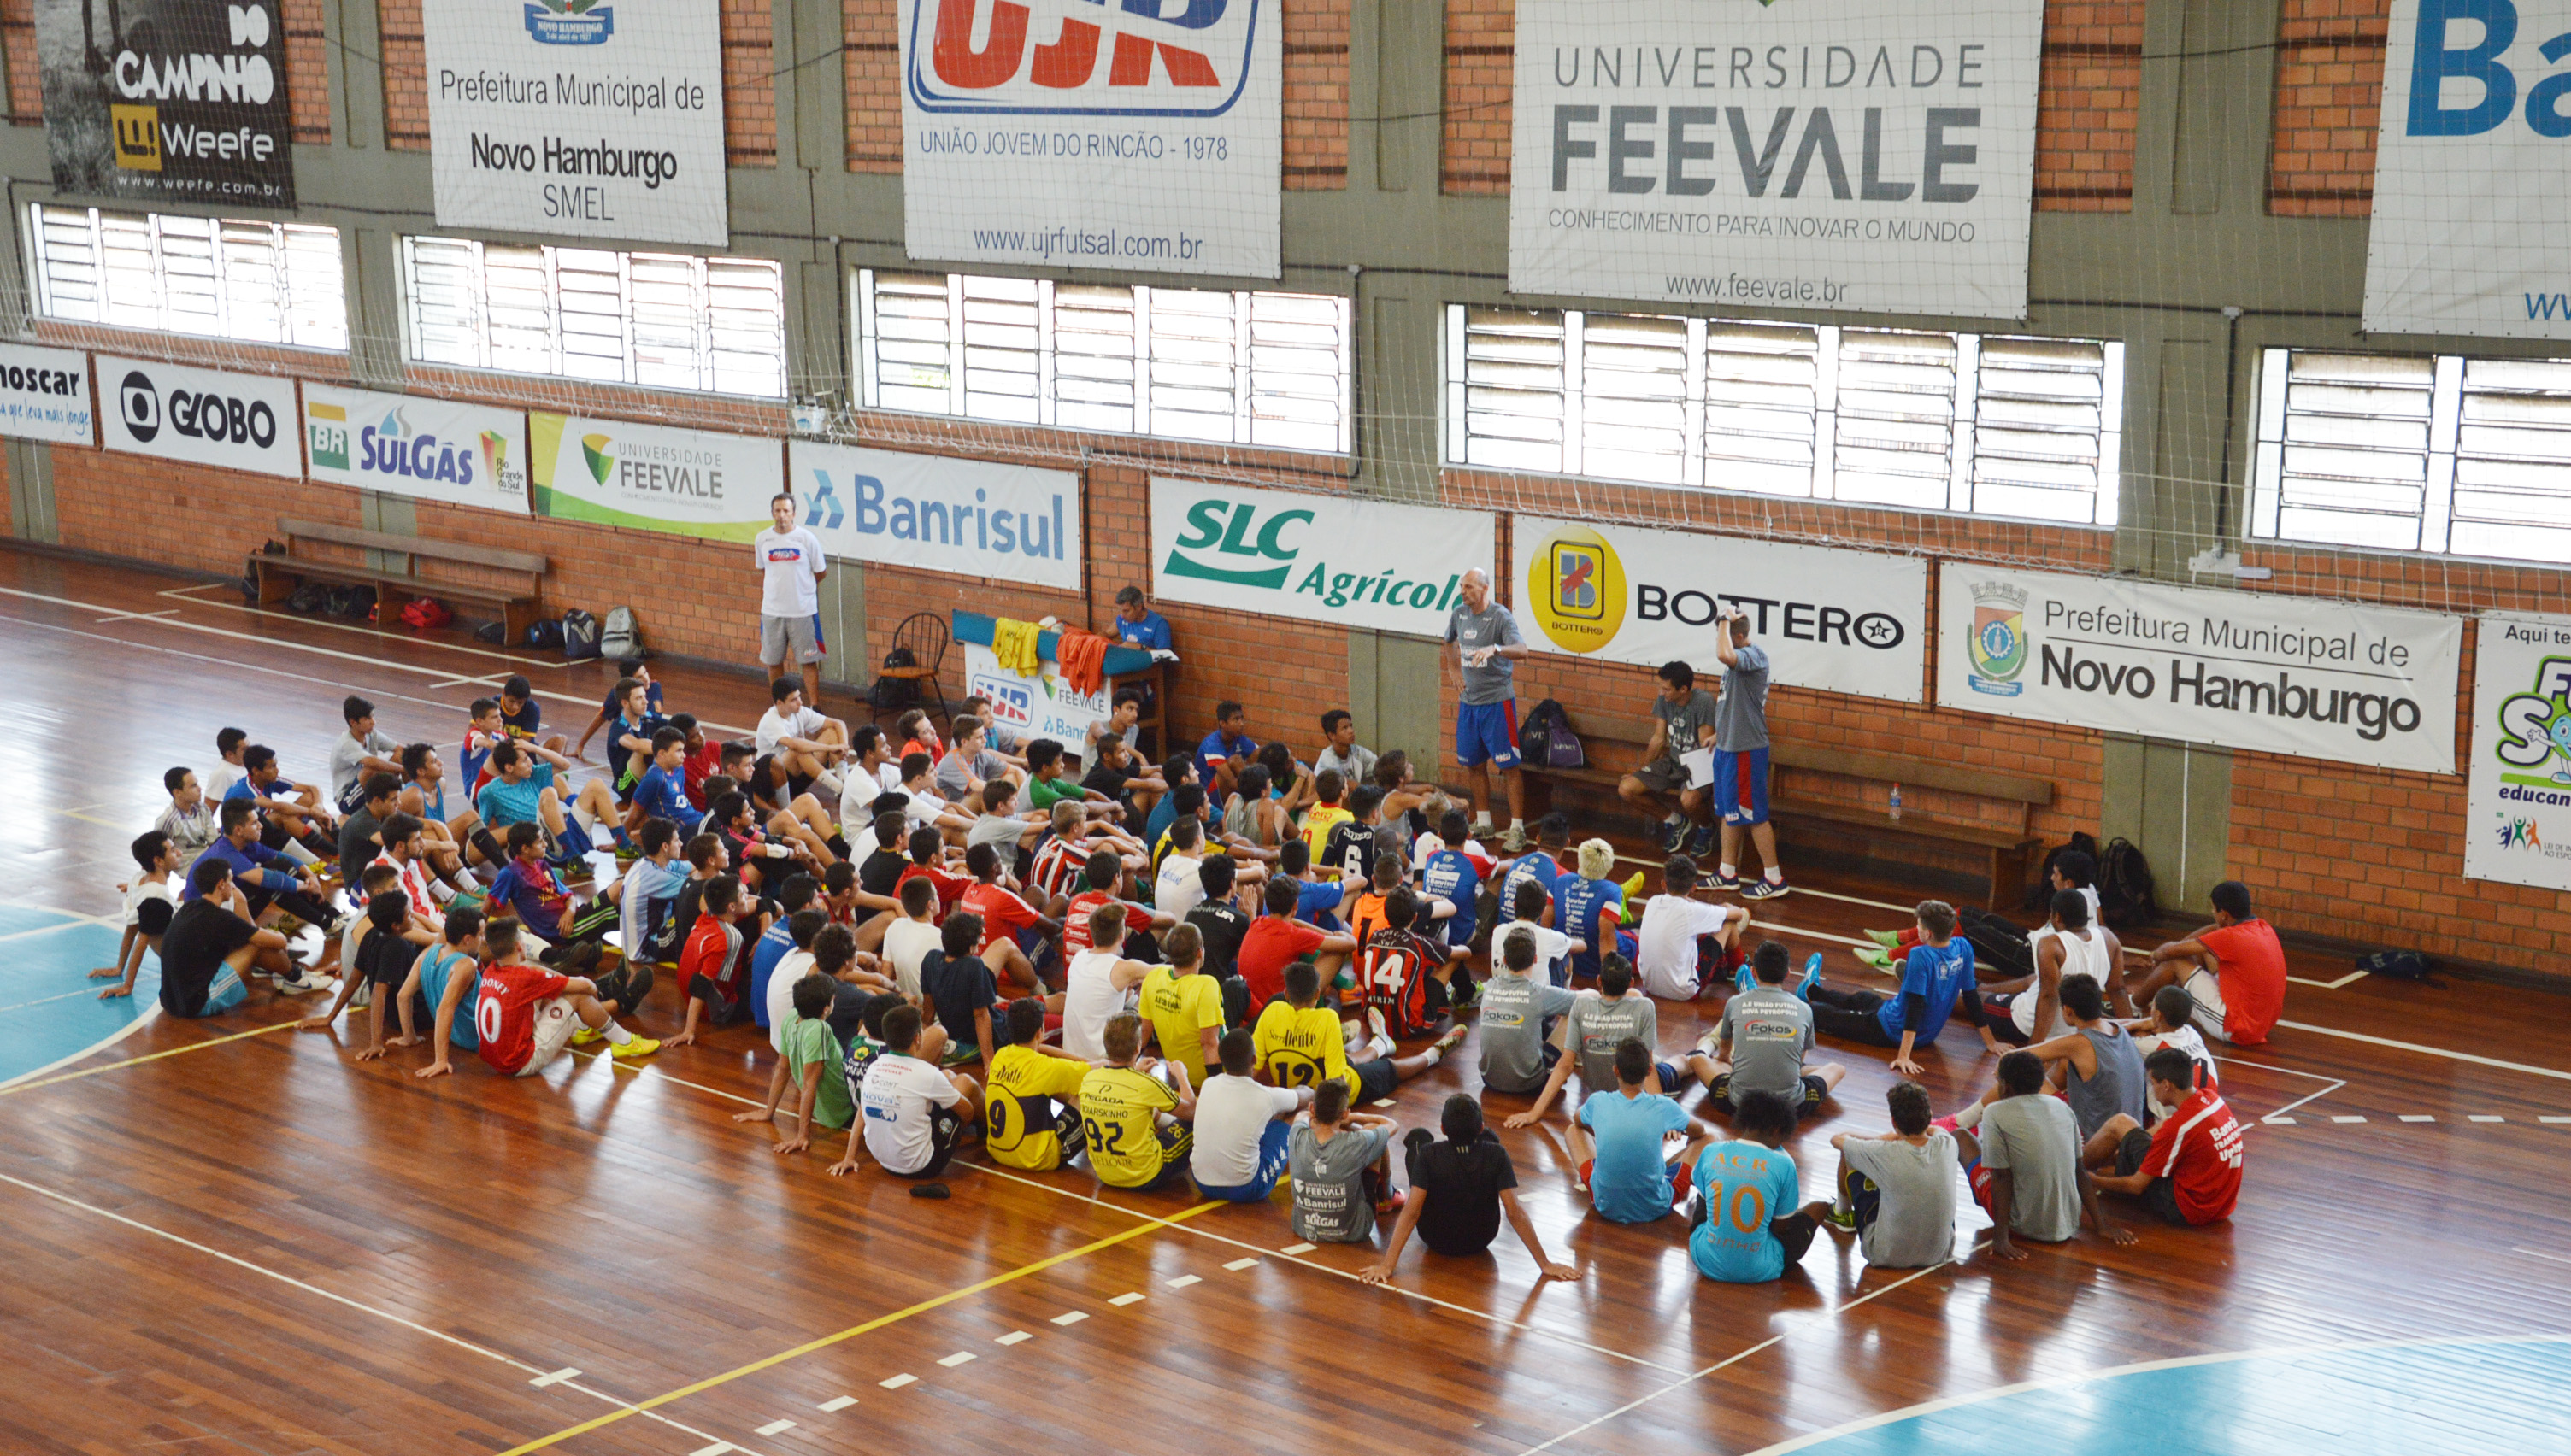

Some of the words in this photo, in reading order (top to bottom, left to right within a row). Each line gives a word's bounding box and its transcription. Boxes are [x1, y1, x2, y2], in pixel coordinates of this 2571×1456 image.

[228, 4, 269, 47] DO
[115, 50, 274, 104] CAMPINHO
[1554, 44, 1985, 89] UNIVERSIDADE
[440, 69, 548, 104] Prefeitura
[556, 73, 666, 115] Municipal
[675, 78, 704, 110] de
[161, 122, 274, 161] Weefe
[921, 127, 977, 155] UNIÃO
[983, 131, 1047, 157] JOVEM
[1053, 132, 1081, 157] DO
[1087, 131, 1163, 160] RINCÃO
[1184, 137, 1227, 161] 1978
[1551, 104, 1981, 203] FEEVALE
[471, 132, 536, 172] Novo
[543, 136, 677, 190] Hamburgo
[117, 175, 281, 197] www.weefe.com.br
[544, 184, 615, 220] SMEL
[973, 226, 1203, 259] www.ujrfutsal.com.br
[1548, 208, 1710, 235] CONHECIMENTO
[1716, 214, 1773, 237] PARA
[1778, 216, 1859, 240] INOVAR
[1865, 219, 1881, 241] O
[1887, 220, 1975, 244] MUNDO
[1666, 273, 1847, 303] www.feevale.br
[169, 389, 276, 449] GLOBO
[314, 426, 345, 455] BR
[618, 442, 722, 467] UNIVERSIDADE
[620, 461, 724, 499] FEEVALE
[855, 473, 1064, 561] Banrisul
[1176, 499, 1315, 561] SLC
[1551, 621, 1604, 636] BOTTERO
[2045, 599, 2189, 643] Prefeitura
[2202, 617, 2357, 665] Municipal
[2368, 637, 2409, 667] de
[2505, 625, 2548, 644] Aqui
[1059, 689, 1105, 713] FEEVALE
[2041, 644, 2155, 699] Novo
[2170, 659, 2421, 742] Hamburgo
[1344, 844, 1362, 878] 6
[1364, 949, 1406, 995] 14
[1483, 1010, 1519, 1021] Fokos
[1751, 1024, 1791, 1034] Fokos
[1760, 1009, 1798, 1017] PETRÓPOLIS
[1275, 1061, 1315, 1089] 12
[989, 1099, 1007, 1139] 9
[1084, 1117, 1127, 1156] 92
[1167, 1122, 1185, 1140] 26
[1304, 1198, 1347, 1209] Banrisul
[1306, 1187, 1346, 1196] FEEVALE
[1711, 1179, 1765, 1235] 10
